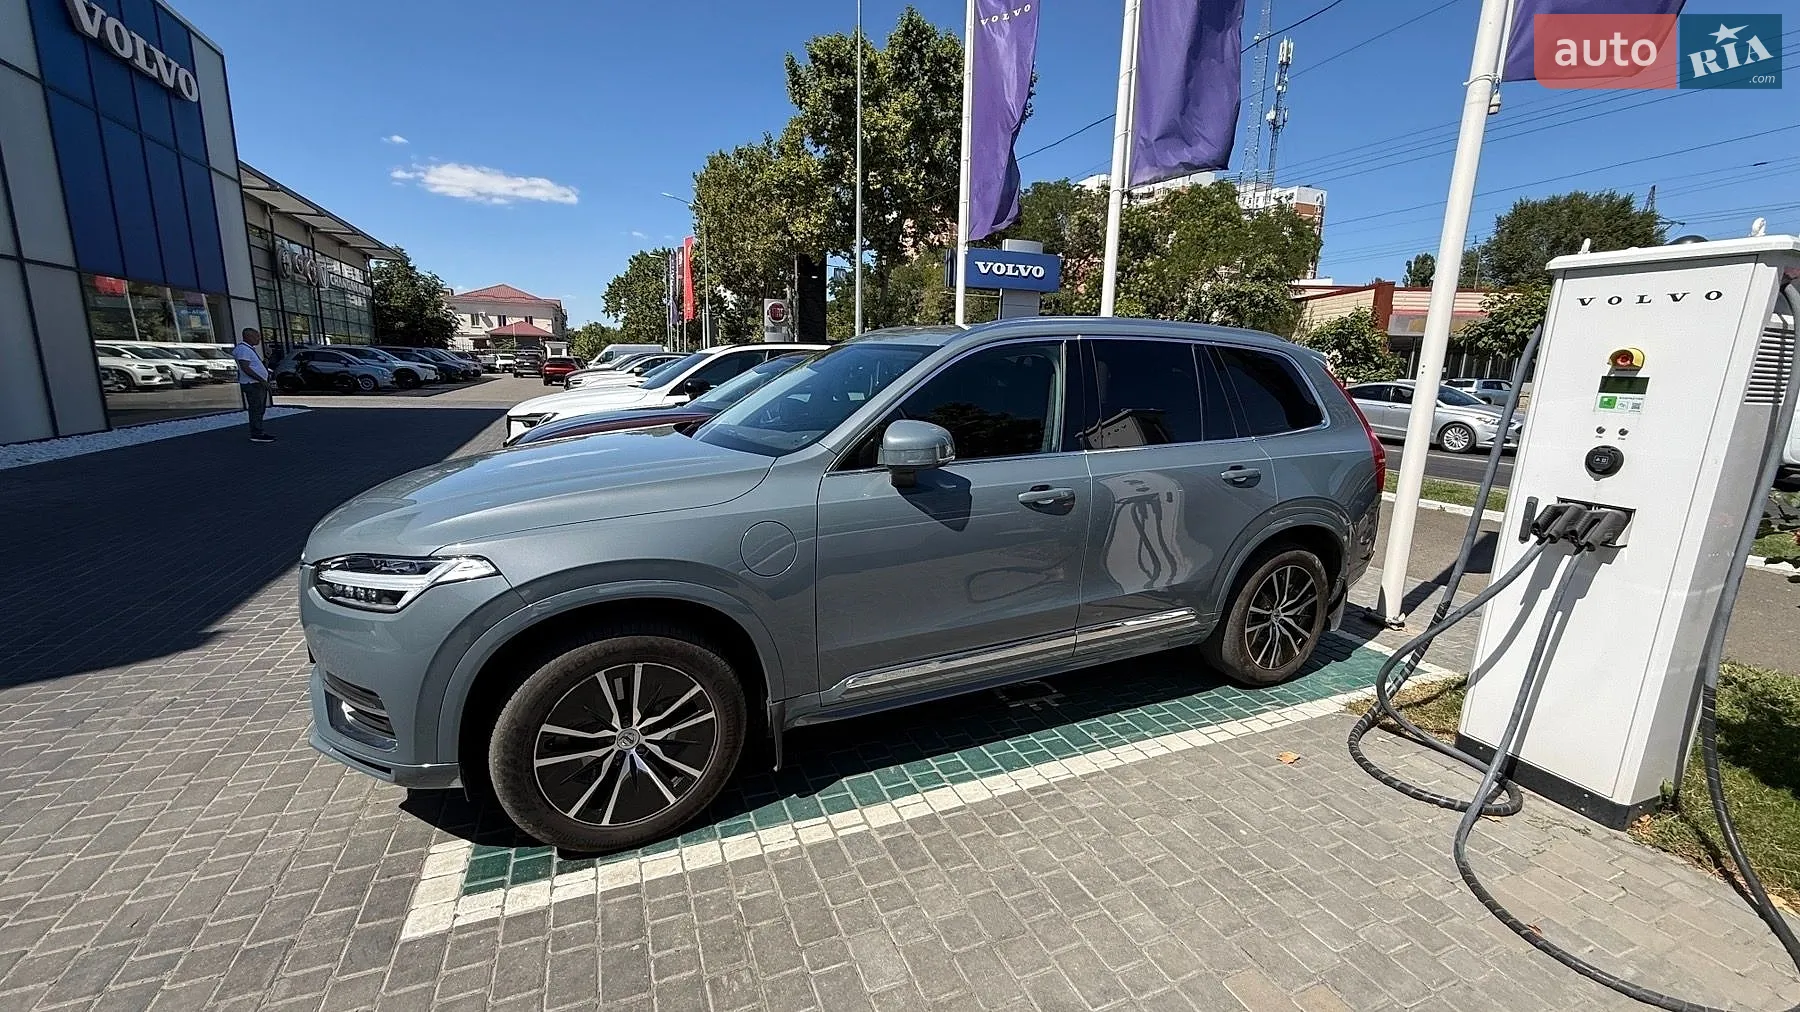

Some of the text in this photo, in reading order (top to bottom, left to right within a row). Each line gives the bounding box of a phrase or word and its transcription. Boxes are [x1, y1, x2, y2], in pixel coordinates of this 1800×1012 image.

[980, 4, 1031, 25] VOLVO
[73, 0, 199, 102] VOLVO
[975, 261, 1045, 278] VOLVO
[1576, 290, 1723, 306] VOLVO
